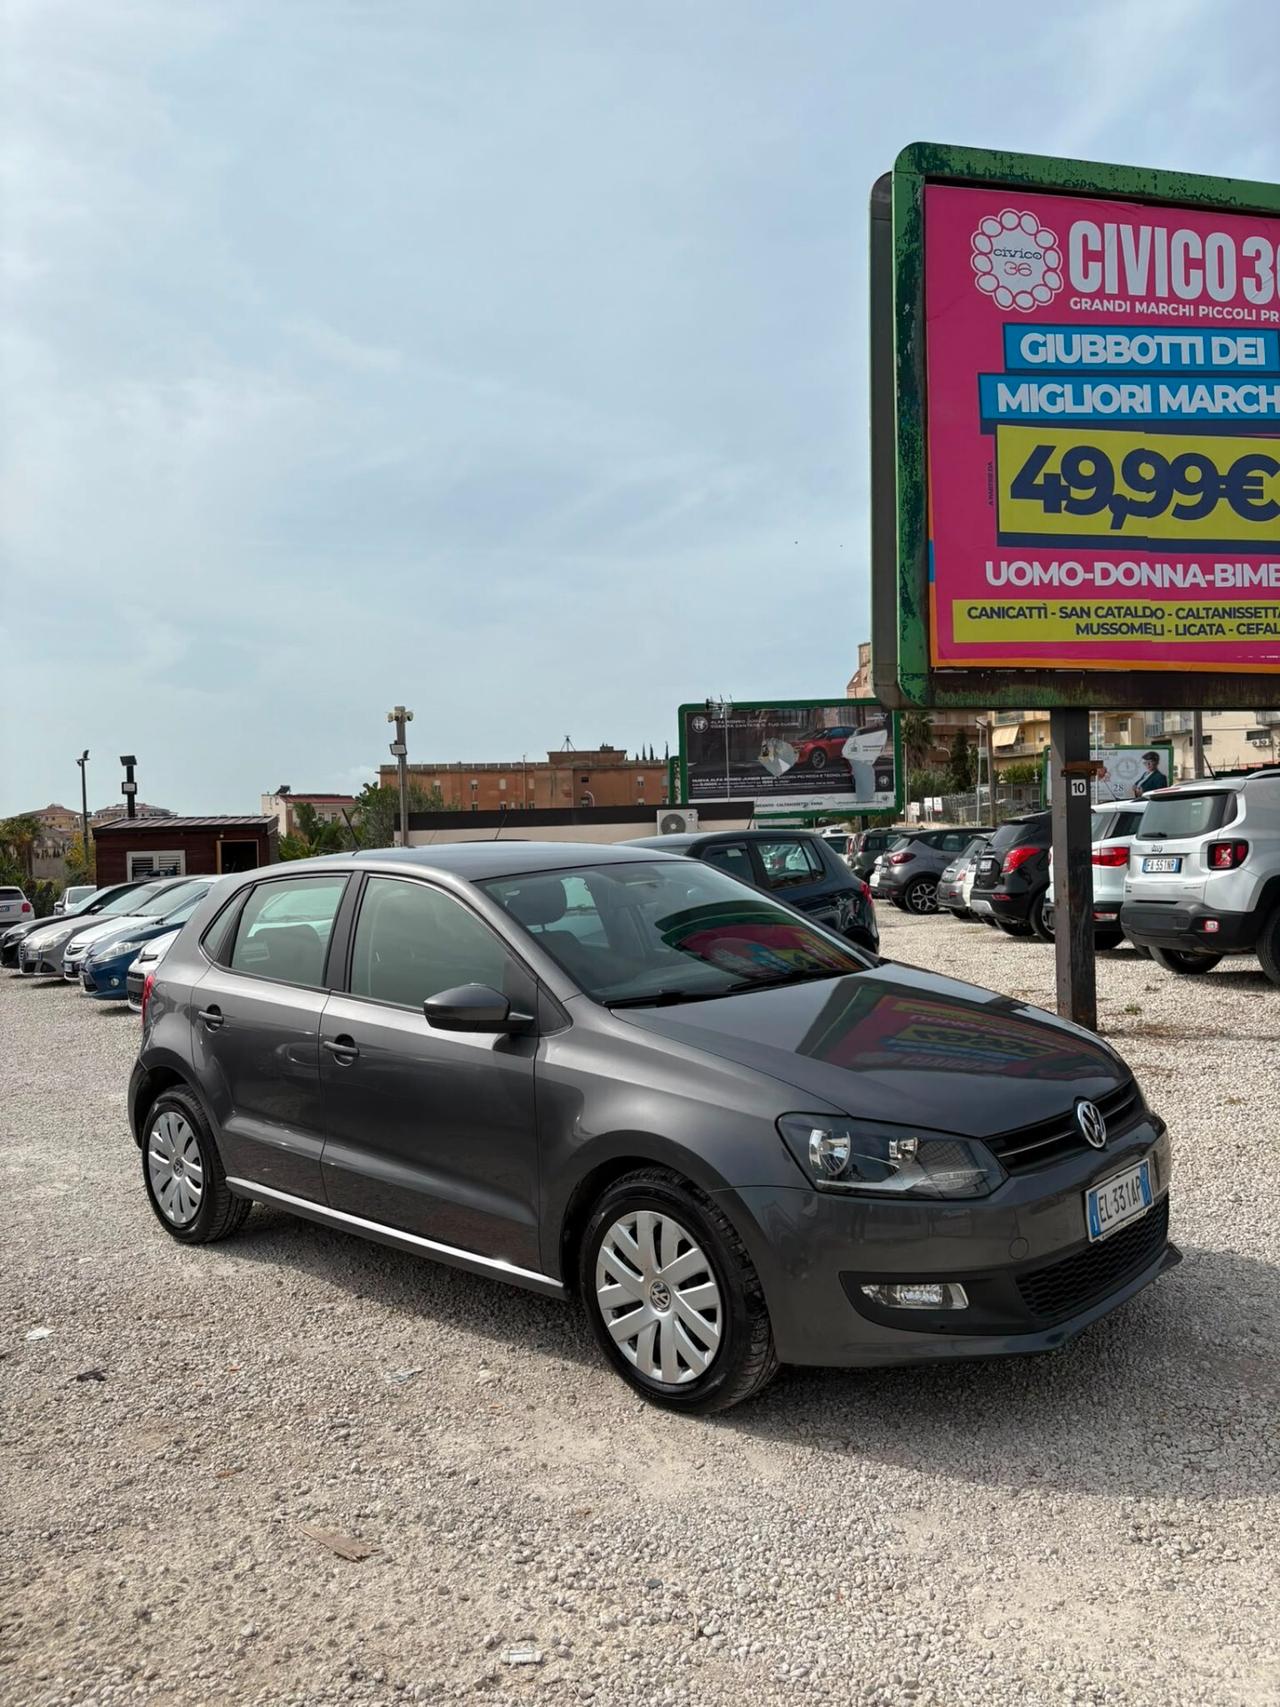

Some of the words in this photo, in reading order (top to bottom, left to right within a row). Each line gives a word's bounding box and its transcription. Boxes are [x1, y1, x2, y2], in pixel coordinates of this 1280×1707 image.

[993, 248, 1042, 260] civico
[1004, 261, 1032, 277] 36
[1242, 235, 1280, 305] 3
[1070, 298, 1131, 313] GRANDI
[1135, 302, 1194, 317] MARCHI
[1199, 305, 1256, 321] PICCOLI
[1020, 333, 1204, 365] GIUBBOTTI
[1211, 336, 1266, 366] DEI
[997, 383, 1152, 414] MIGLIORI
[1159, 384, 1280, 414] MARCH
[1010, 445, 1280, 530] 49,99€
[967, 603, 1048, 619] CANICATTÌ
[1059, 606, 1091, 619] SAN
[1094, 606, 1165, 620] CATALDO
[1075, 622, 1164, 636] MUSSOMELI
[1175, 623, 1226, 636] LICATA
[1072, 782, 1085, 794] 10
[1098, 1194, 1113, 1222] EL
